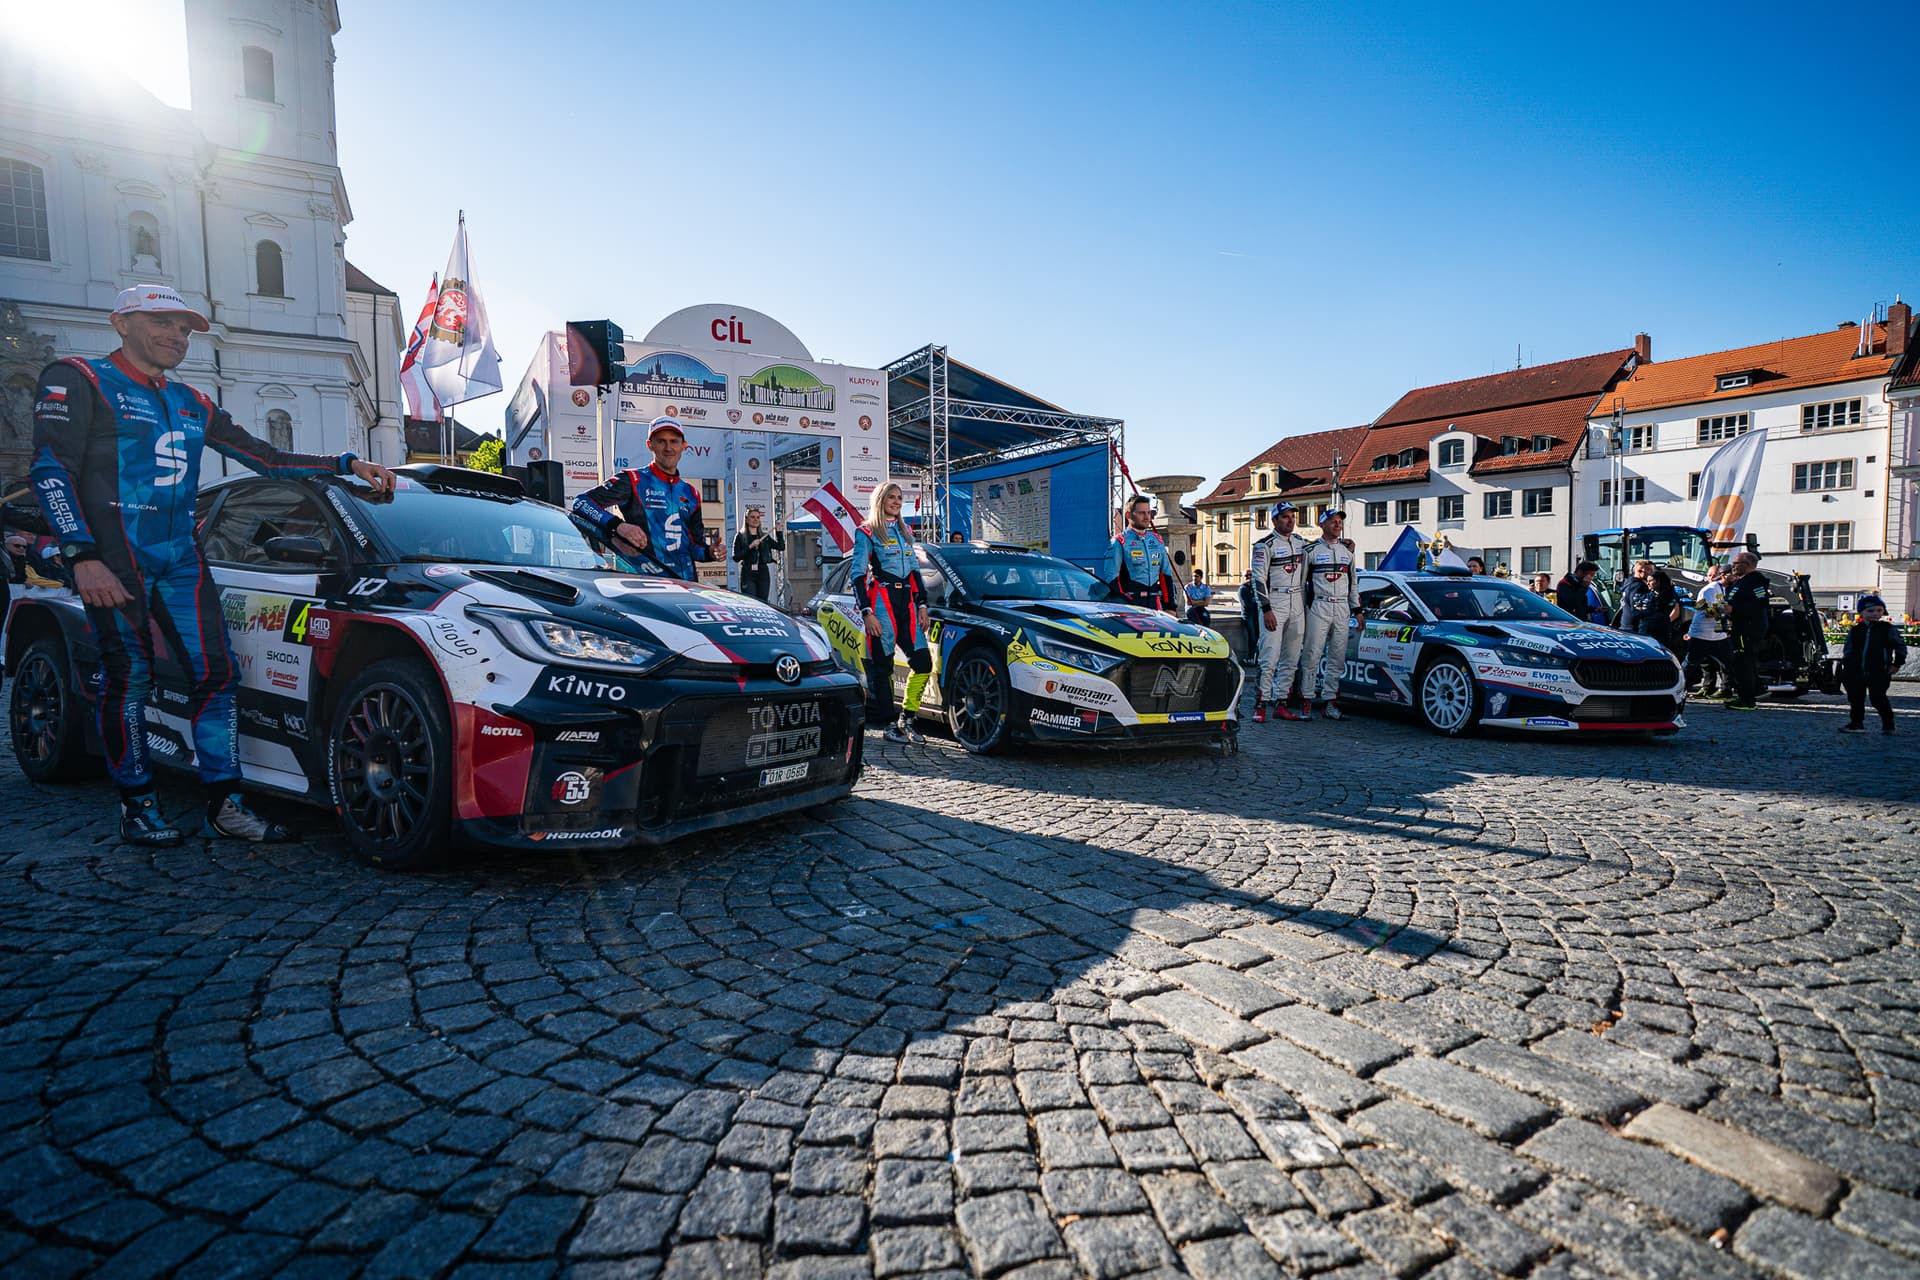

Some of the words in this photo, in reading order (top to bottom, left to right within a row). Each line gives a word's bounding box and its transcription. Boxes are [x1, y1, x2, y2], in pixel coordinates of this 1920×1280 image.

[711, 315, 752, 345] CÍL
[623, 383, 636, 393] 33.
[637, 383, 671, 395] HISTORIC
[291, 603, 311, 642] 4
[688, 610, 737, 622] GR
[436, 623, 477, 655] group
[723, 625, 789, 637] Czech
[931, 621, 941, 642] 6
[1401, 626, 1411, 642] 2
[747, 702, 821, 730] TOYOTA
[1030, 708, 1081, 727] PRAMMER
[481, 725, 523, 737] MOTUL
